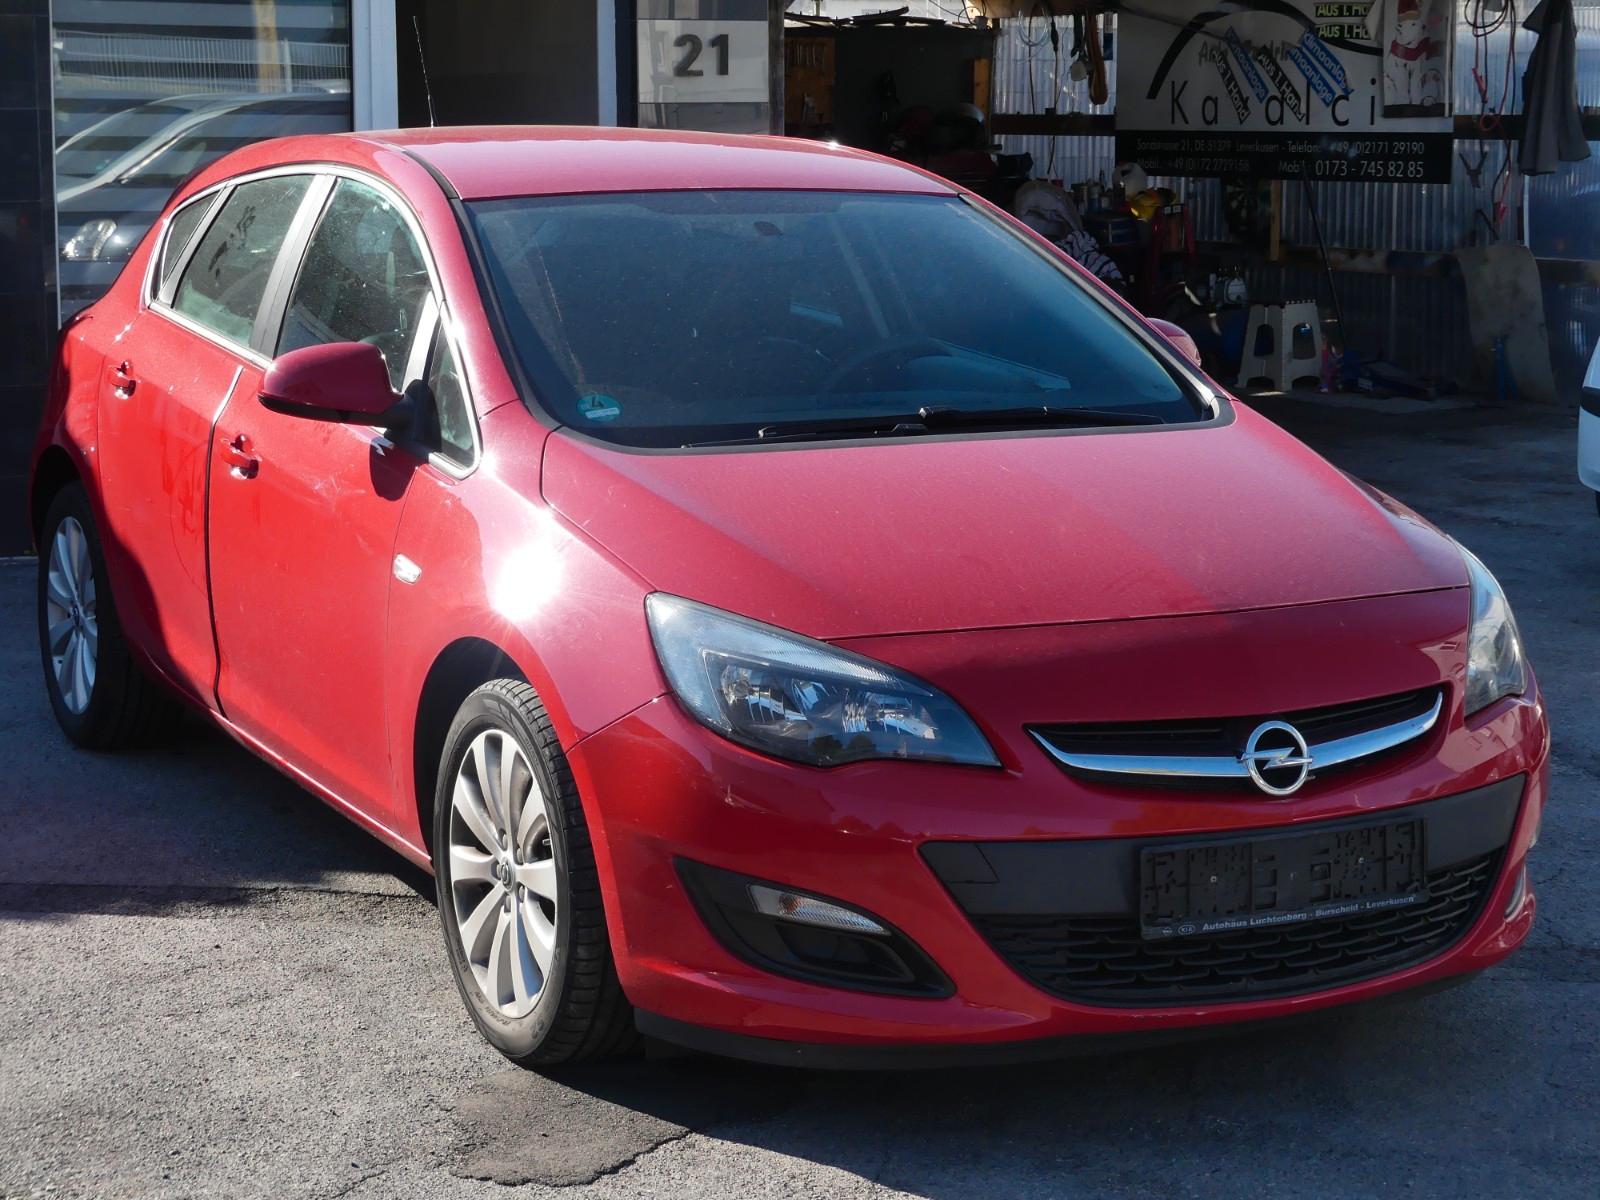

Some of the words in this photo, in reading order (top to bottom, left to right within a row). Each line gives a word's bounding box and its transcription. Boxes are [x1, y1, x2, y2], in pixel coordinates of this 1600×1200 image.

[673, 34, 729, 77] 21
[1171, 77, 1376, 126] Kaalci
[1393, 142, 1425, 155] 29190
[1315, 160, 1347, 176] 0173
[1360, 161, 1384, 177] 745
[1387, 161, 1404, 178] 82
[1408, 161, 1424, 178] 85
[1202, 919, 1248, 932] Autohaus
[1315, 903, 1359, 919] Burscheid
